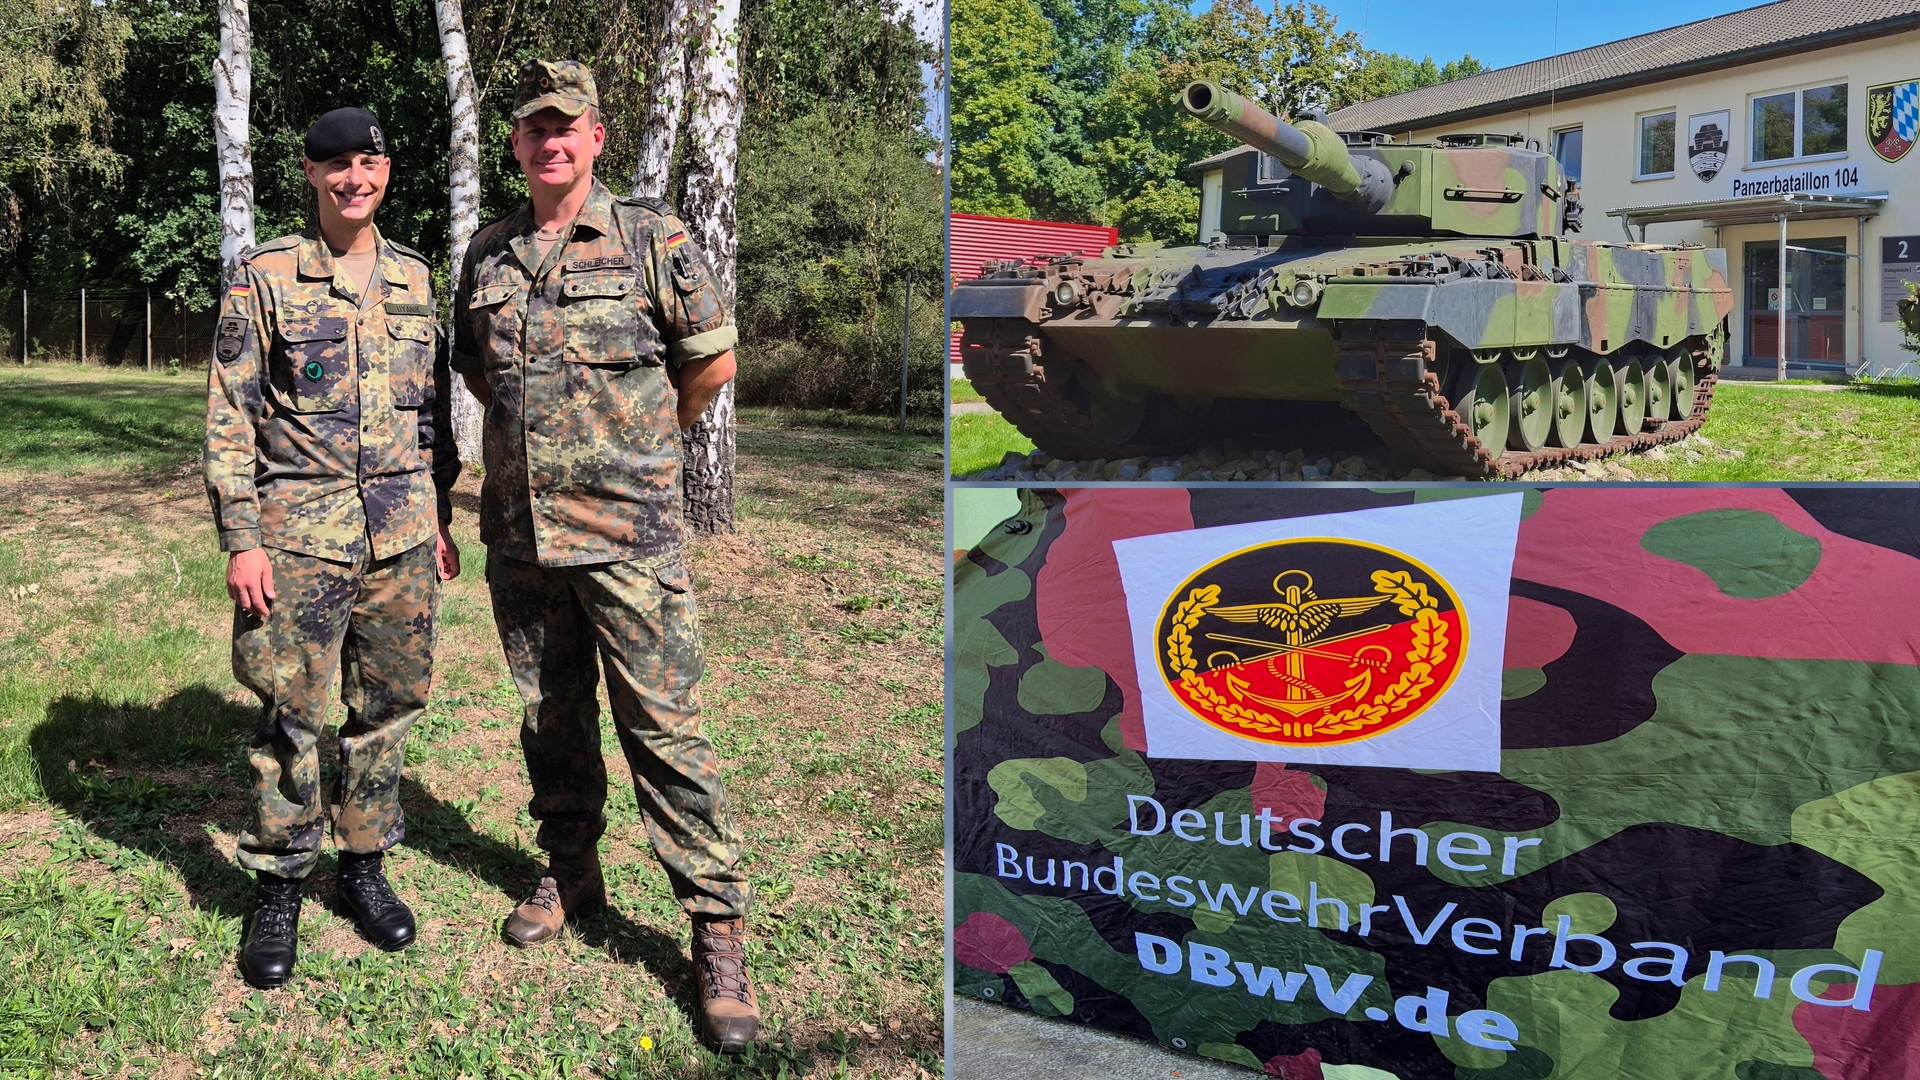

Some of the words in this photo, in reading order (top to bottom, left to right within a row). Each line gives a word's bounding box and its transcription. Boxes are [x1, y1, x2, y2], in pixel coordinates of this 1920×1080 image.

[1733, 171, 1830, 197] Panzerbataillon
[1834, 166, 1858, 188] 104
[572, 256, 625, 269] SCHLEICHER
[1898, 240, 1909, 259] 2
[1127, 794, 1543, 876] Deutscher
[995, 842, 1884, 1012] BundeswehrVerband
[1134, 931, 1519, 1051] DBwV.de
